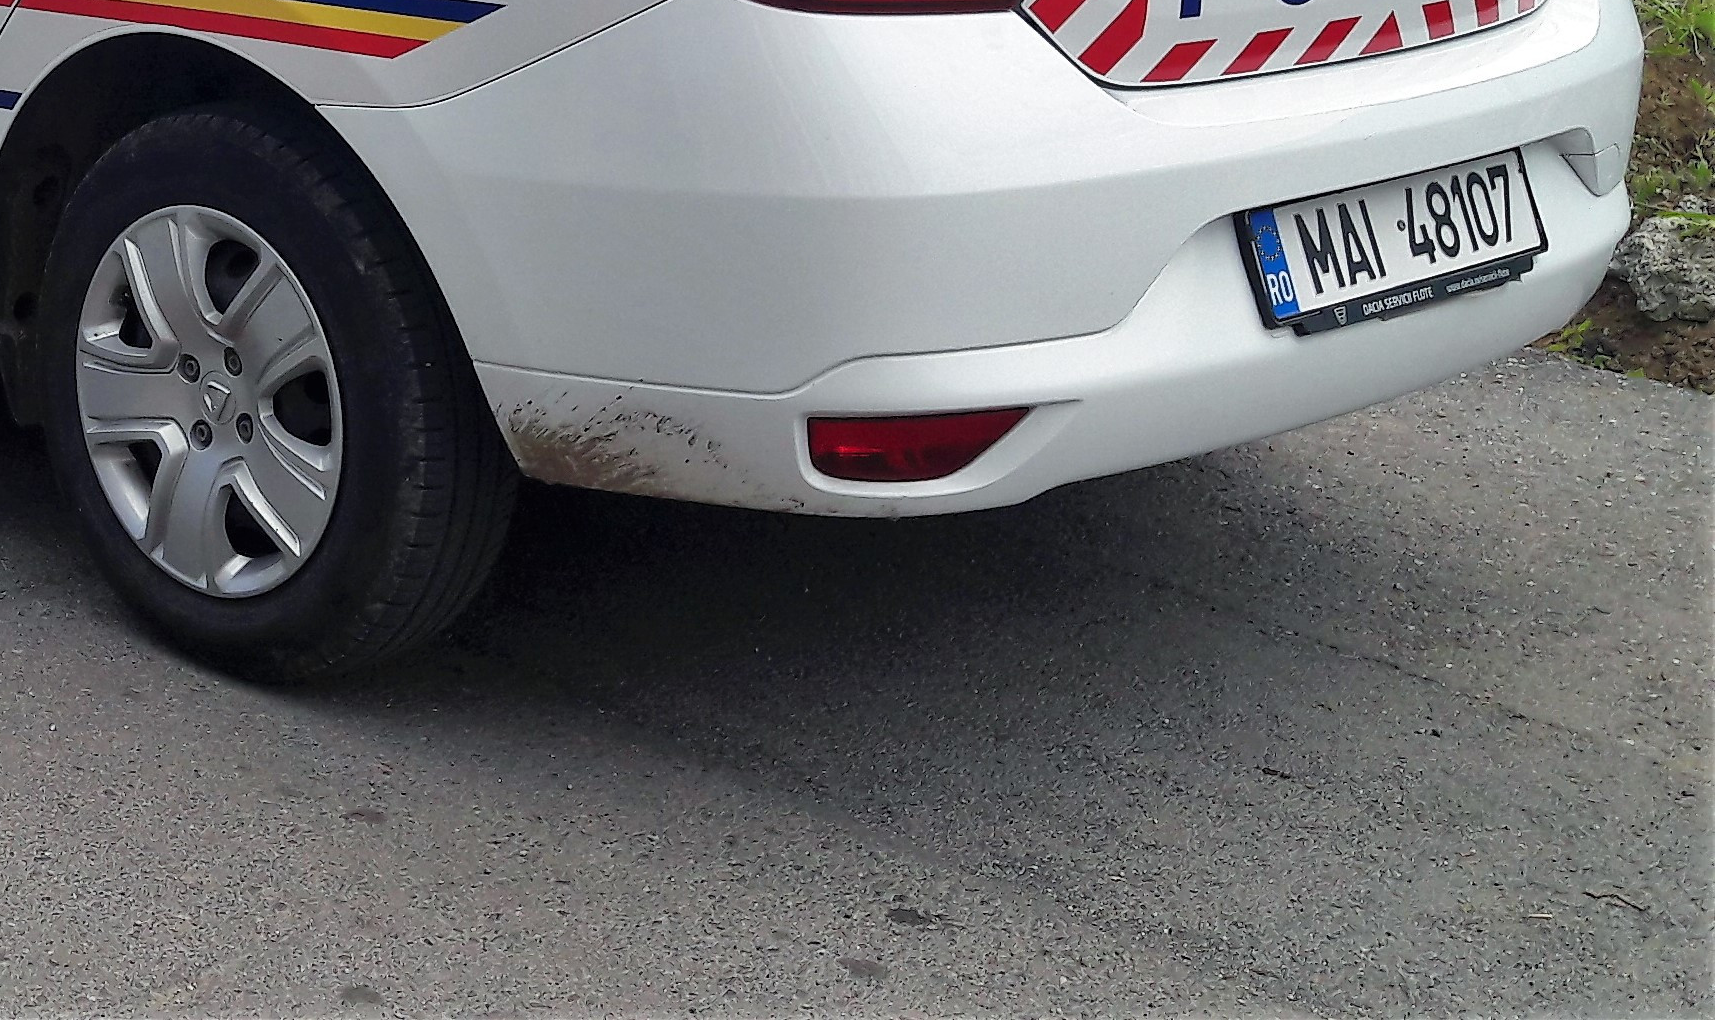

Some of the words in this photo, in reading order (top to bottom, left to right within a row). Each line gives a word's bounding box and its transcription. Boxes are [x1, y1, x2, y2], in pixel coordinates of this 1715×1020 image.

[1292, 199, 1386, 295] MAI
[1404, 164, 1512, 263] 48107
[1268, 271, 1293, 306] RO
[1363, 301, 1384, 315] DACIA
[1412, 287, 1434, 303] FLOTE
